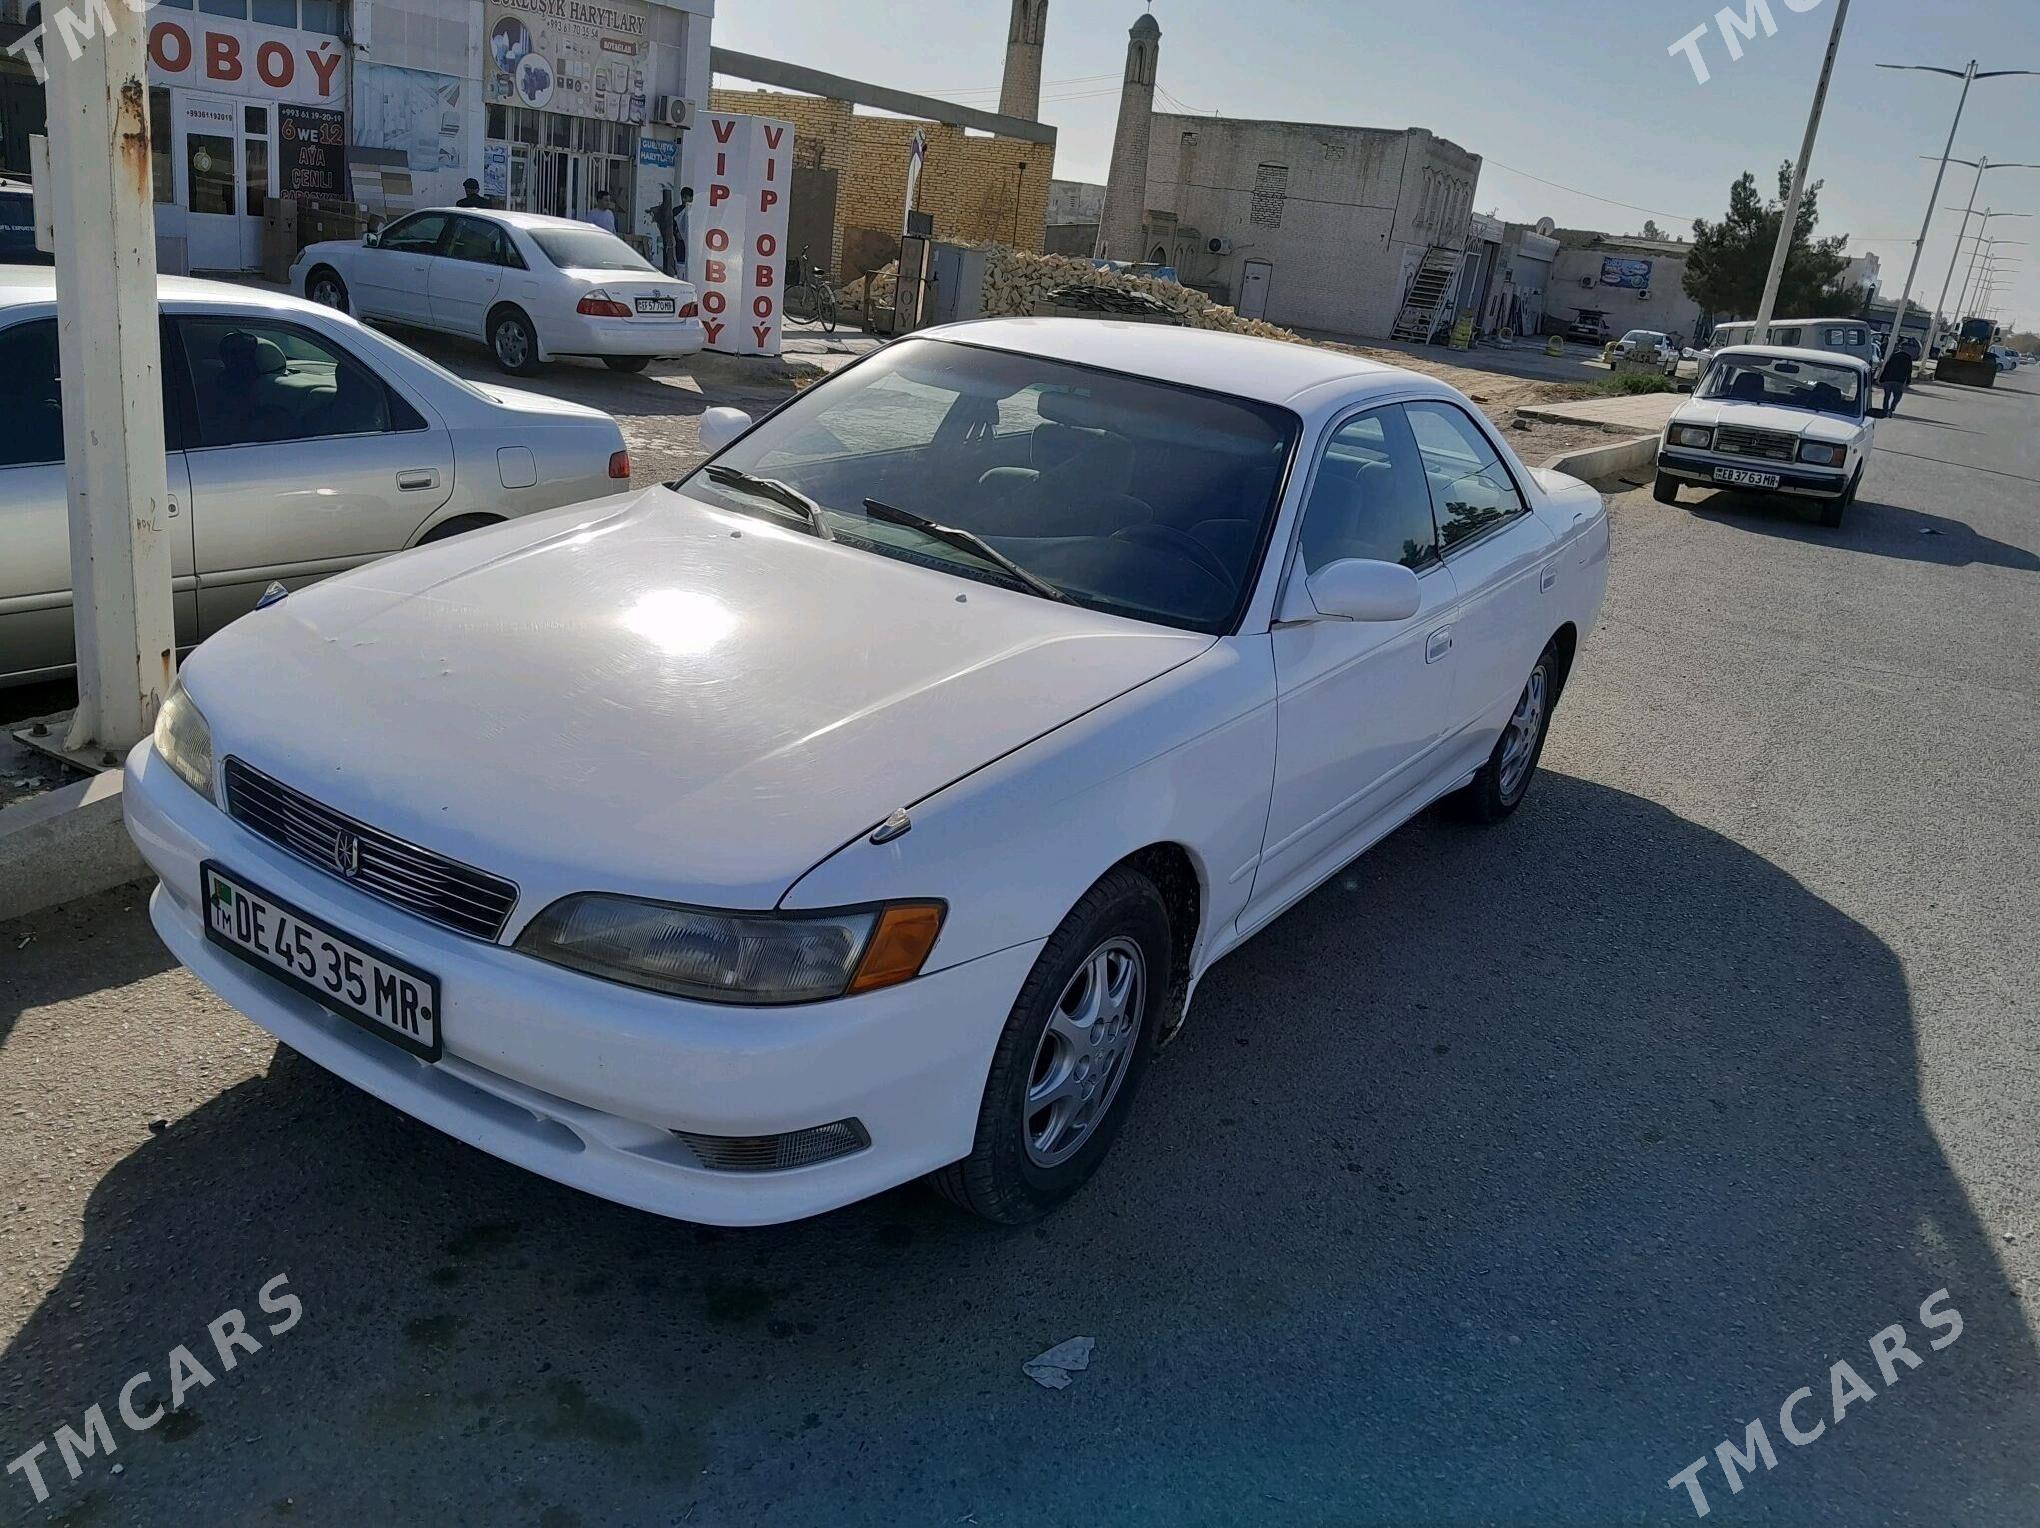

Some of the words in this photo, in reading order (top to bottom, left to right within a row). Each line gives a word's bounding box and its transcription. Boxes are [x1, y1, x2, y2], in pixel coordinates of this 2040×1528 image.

[570, 1, 646, 34] HARYTLARY
[150, 21, 342, 97] OBOÝ
[282, 118, 296, 140] 6
[297, 128, 319, 143] WE
[320, 123, 344, 145] 12
[710, 120, 736, 207] VIP
[760, 125, 784, 213] VIP
[702, 228, 730, 345] OBOÝ
[752, 233, 777, 348] OBOÝ
[215, 906, 232, 935] TM
